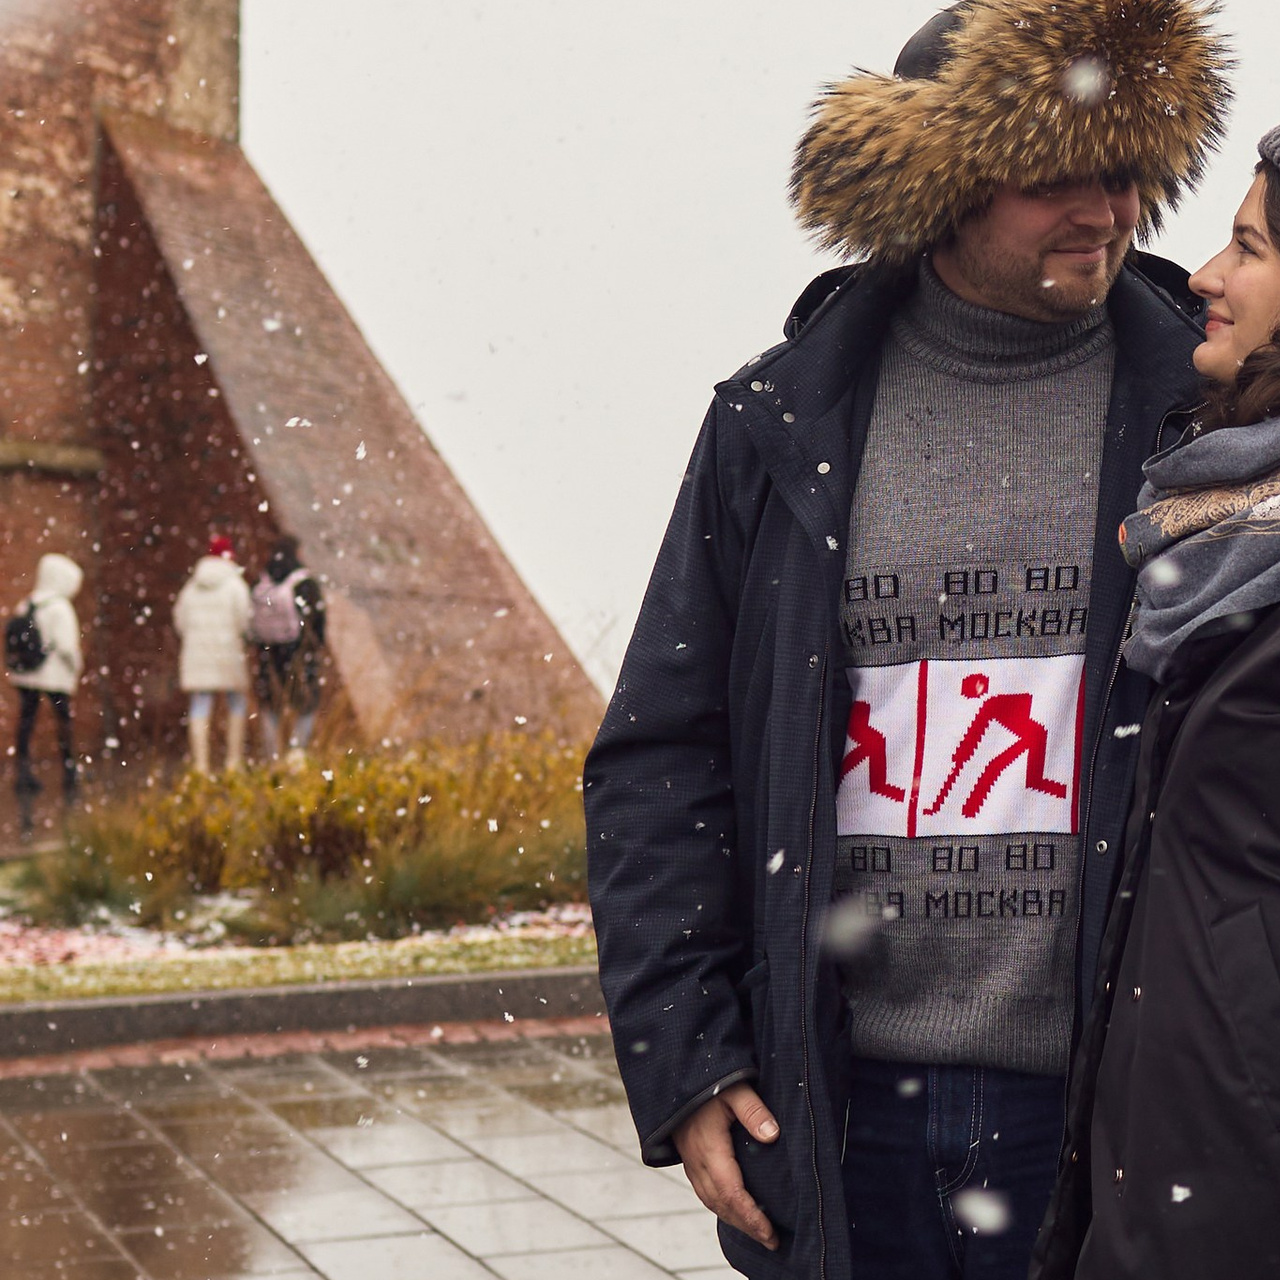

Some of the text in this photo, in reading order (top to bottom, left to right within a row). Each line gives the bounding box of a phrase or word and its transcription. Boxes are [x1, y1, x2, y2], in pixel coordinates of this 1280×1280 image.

[845, 565, 1079, 602] 80 80 80
[939, 608, 1088, 640] МОСКВА
[852, 843, 1055, 872] 80 80 80
[925, 889, 1066, 918] МОСКВА
